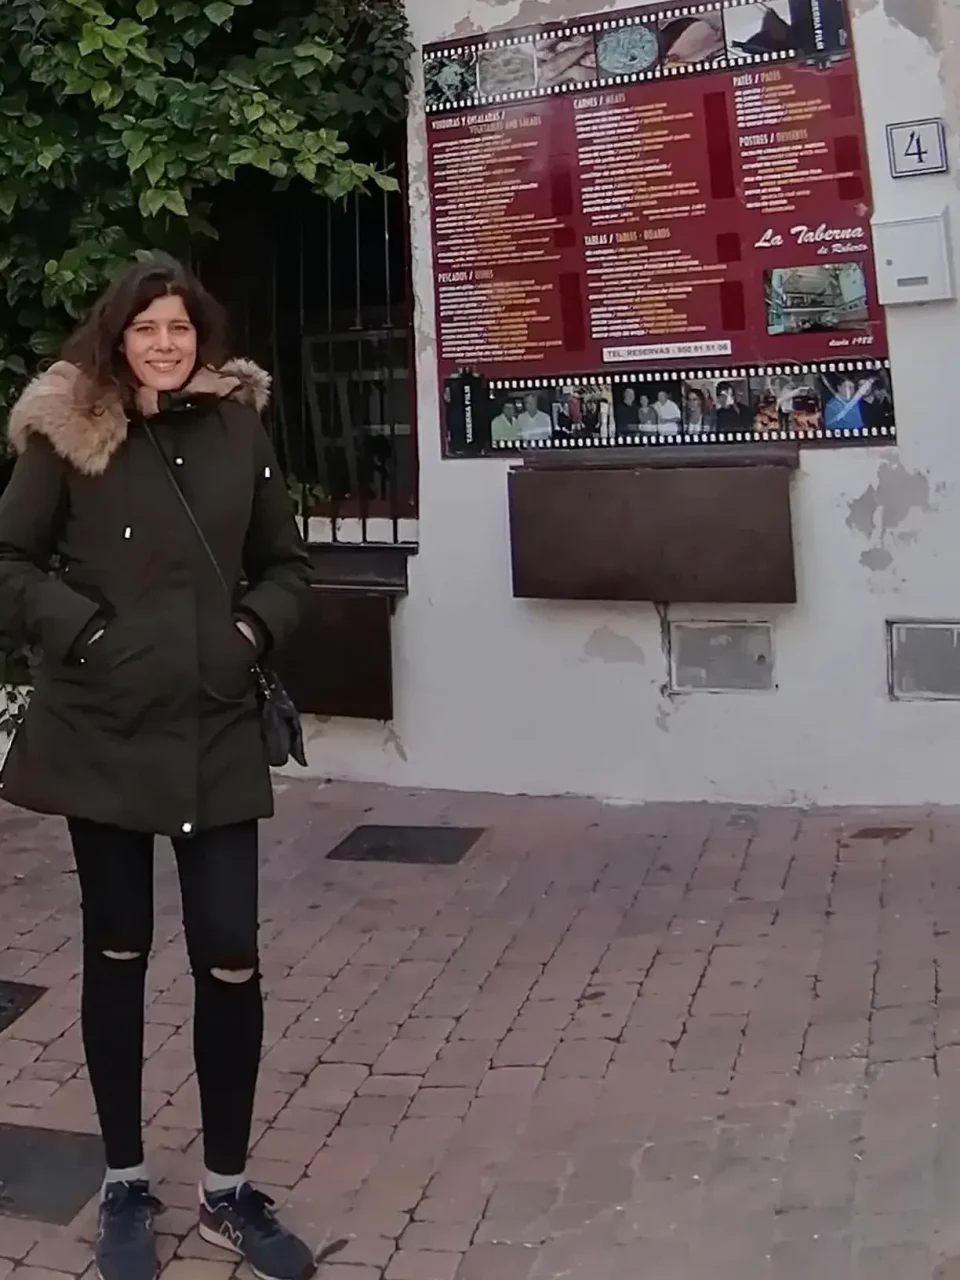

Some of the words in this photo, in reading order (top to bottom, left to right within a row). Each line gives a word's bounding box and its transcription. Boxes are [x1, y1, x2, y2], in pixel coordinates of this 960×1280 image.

[904, 130, 928, 164] 4
[754, 228, 784, 248] La
[790, 223, 865, 245] Taberna
[816, 245, 829, 255] de
[831, 242, 869, 254] Roberto
[627, 346, 671, 357] RESERVAS
